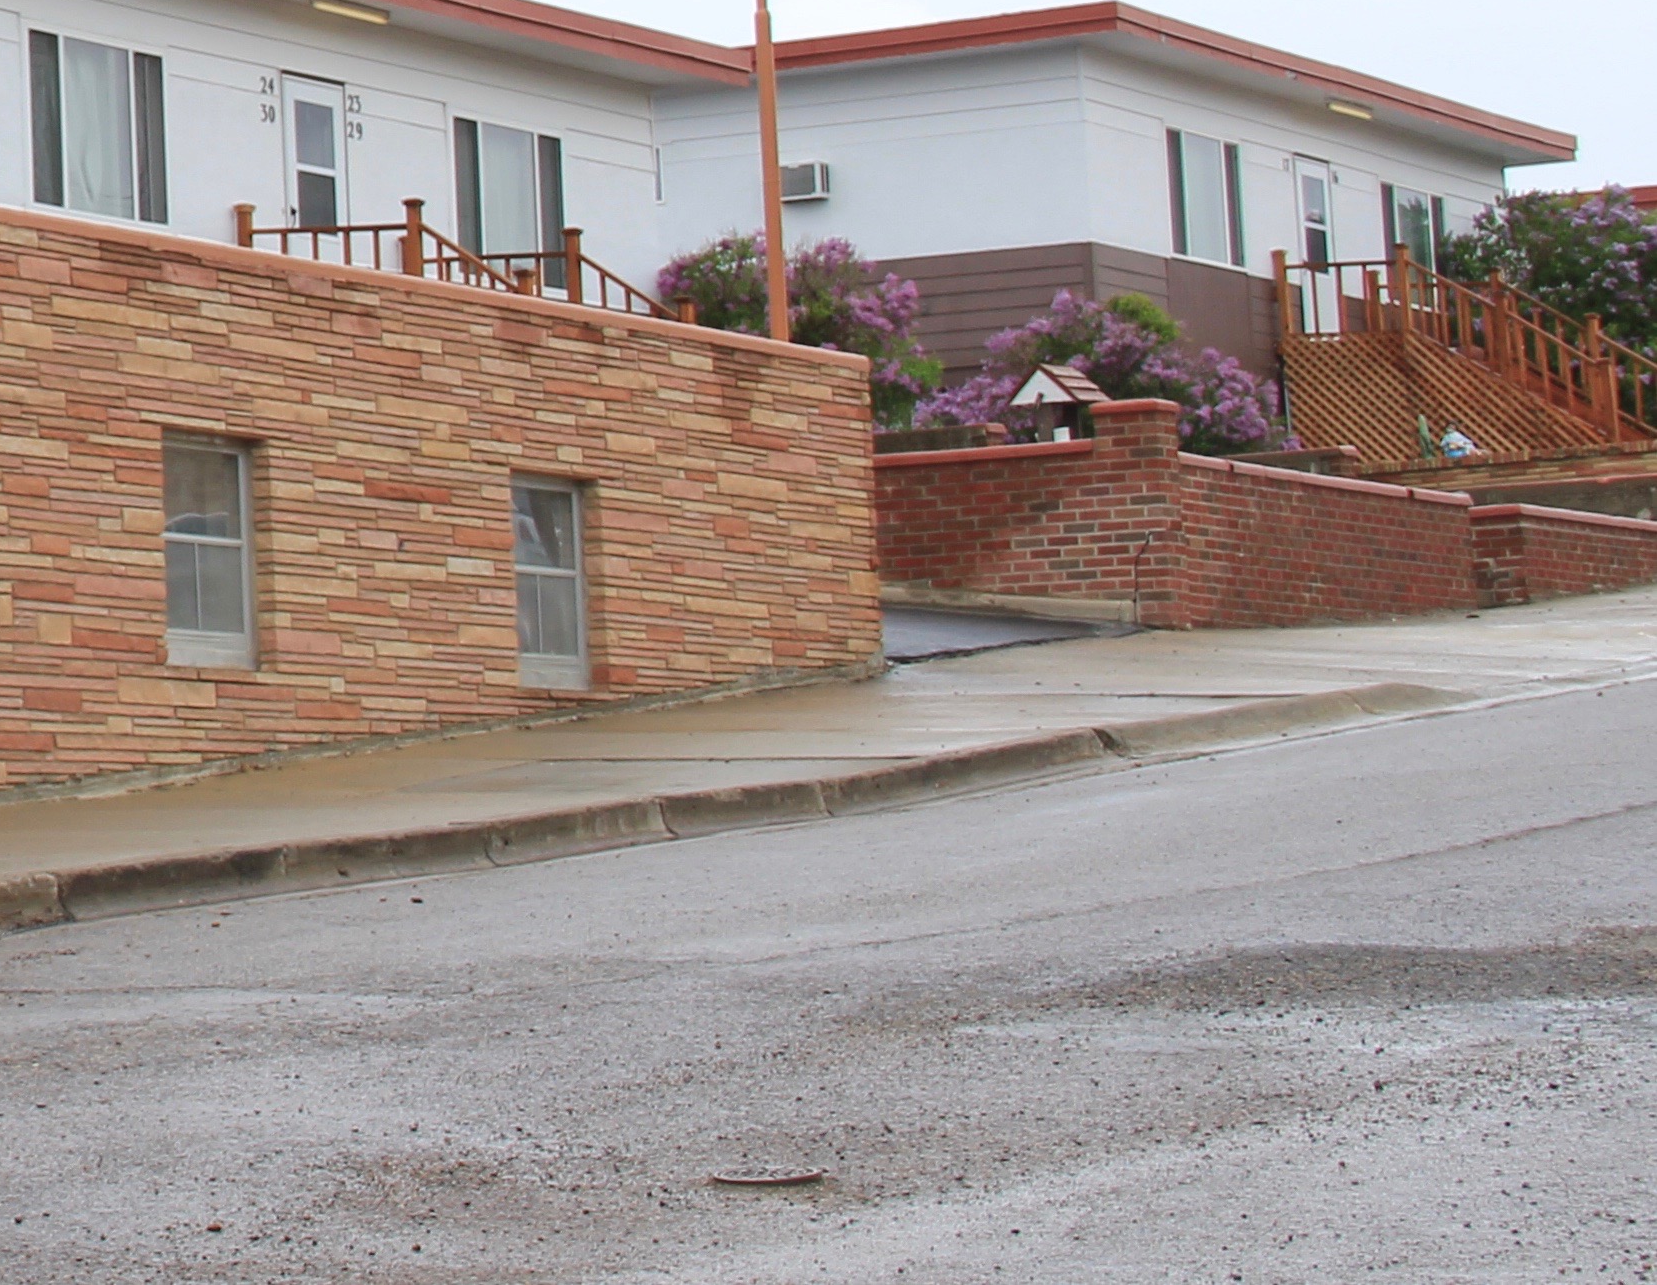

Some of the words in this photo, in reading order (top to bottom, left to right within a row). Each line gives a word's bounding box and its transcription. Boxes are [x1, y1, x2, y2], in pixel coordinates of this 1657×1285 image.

[259, 76, 275, 94] 24
[259, 103, 276, 123] 30
[347, 94, 362, 113] 23
[346, 121, 364, 140] 29
